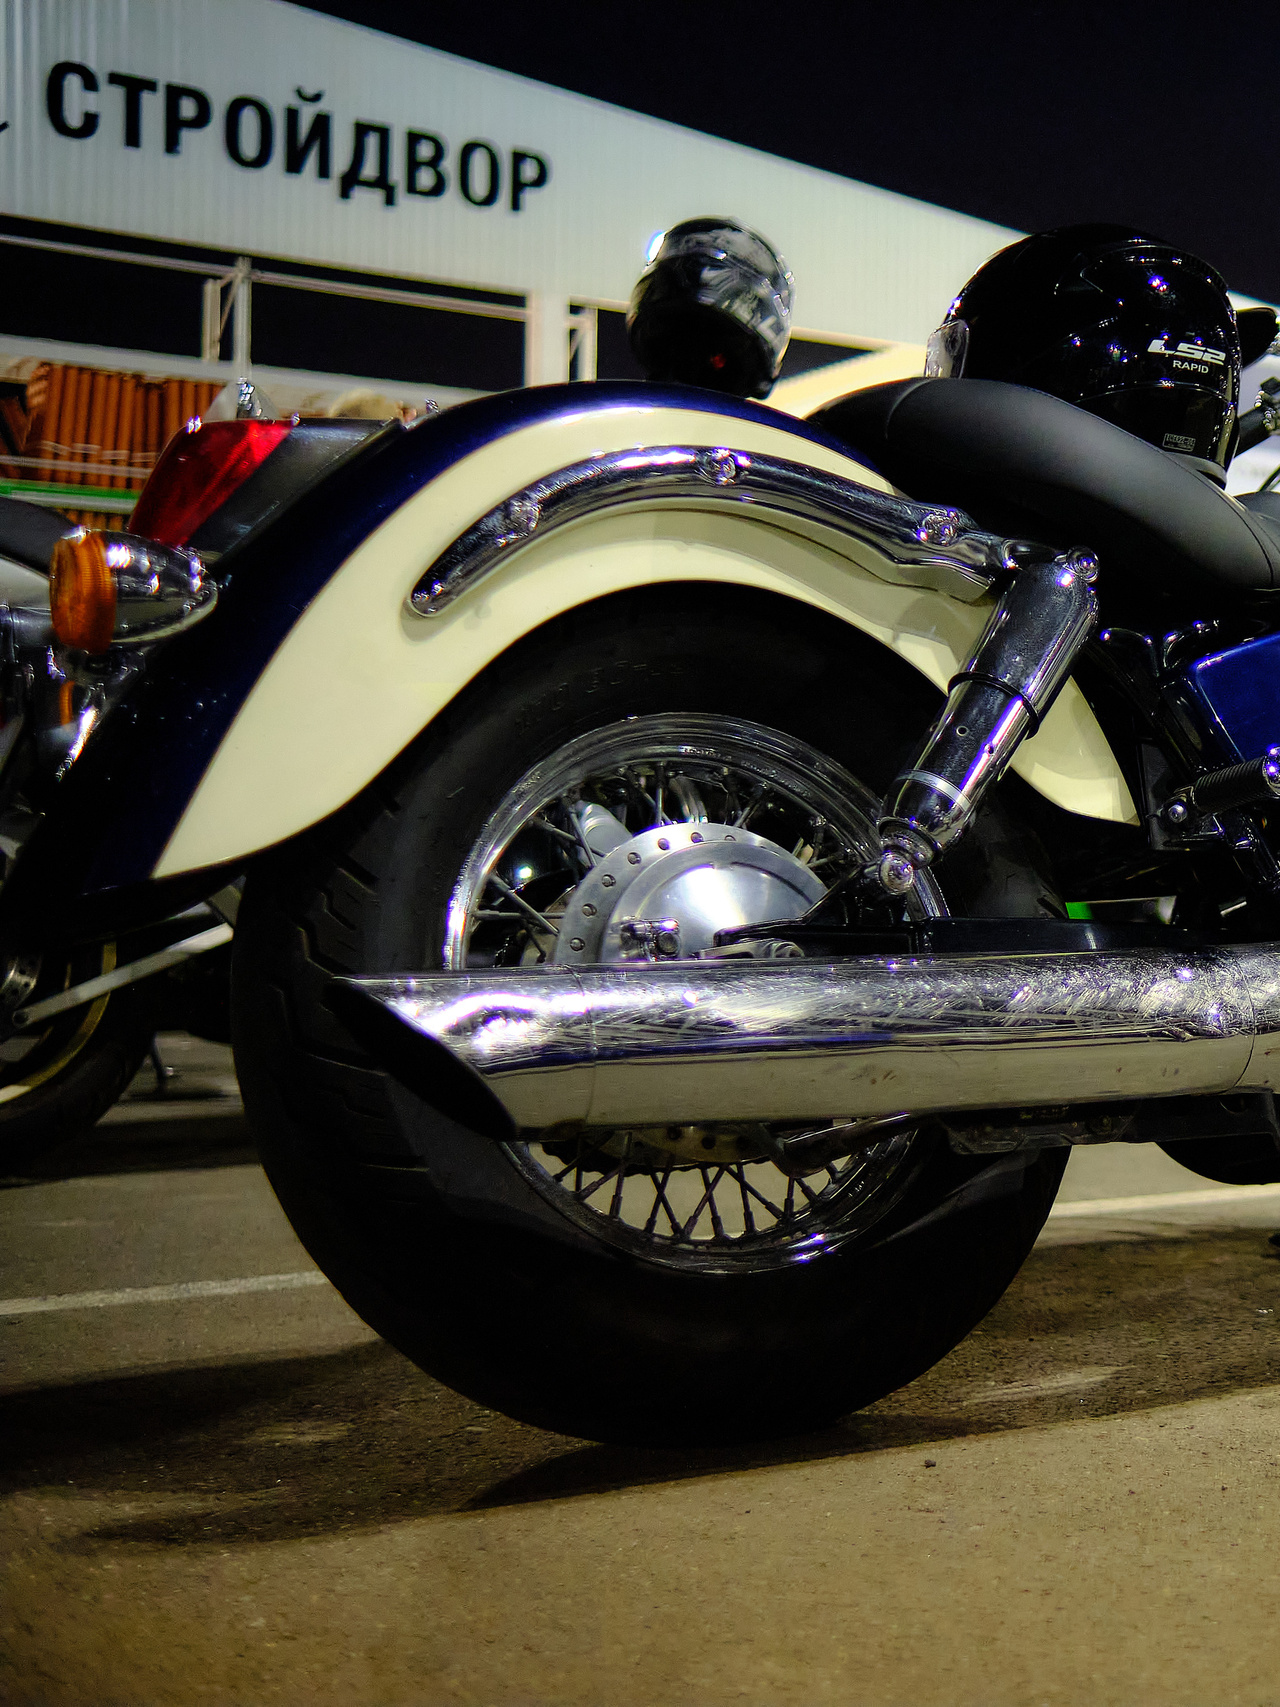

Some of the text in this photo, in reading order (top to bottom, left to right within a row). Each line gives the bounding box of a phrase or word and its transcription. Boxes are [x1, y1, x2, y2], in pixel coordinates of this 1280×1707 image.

[46, 61, 550, 212] СТРОЙДВОР
[1147, 339, 1227, 366] LS2
[1172, 360, 1209, 374] RAPID
